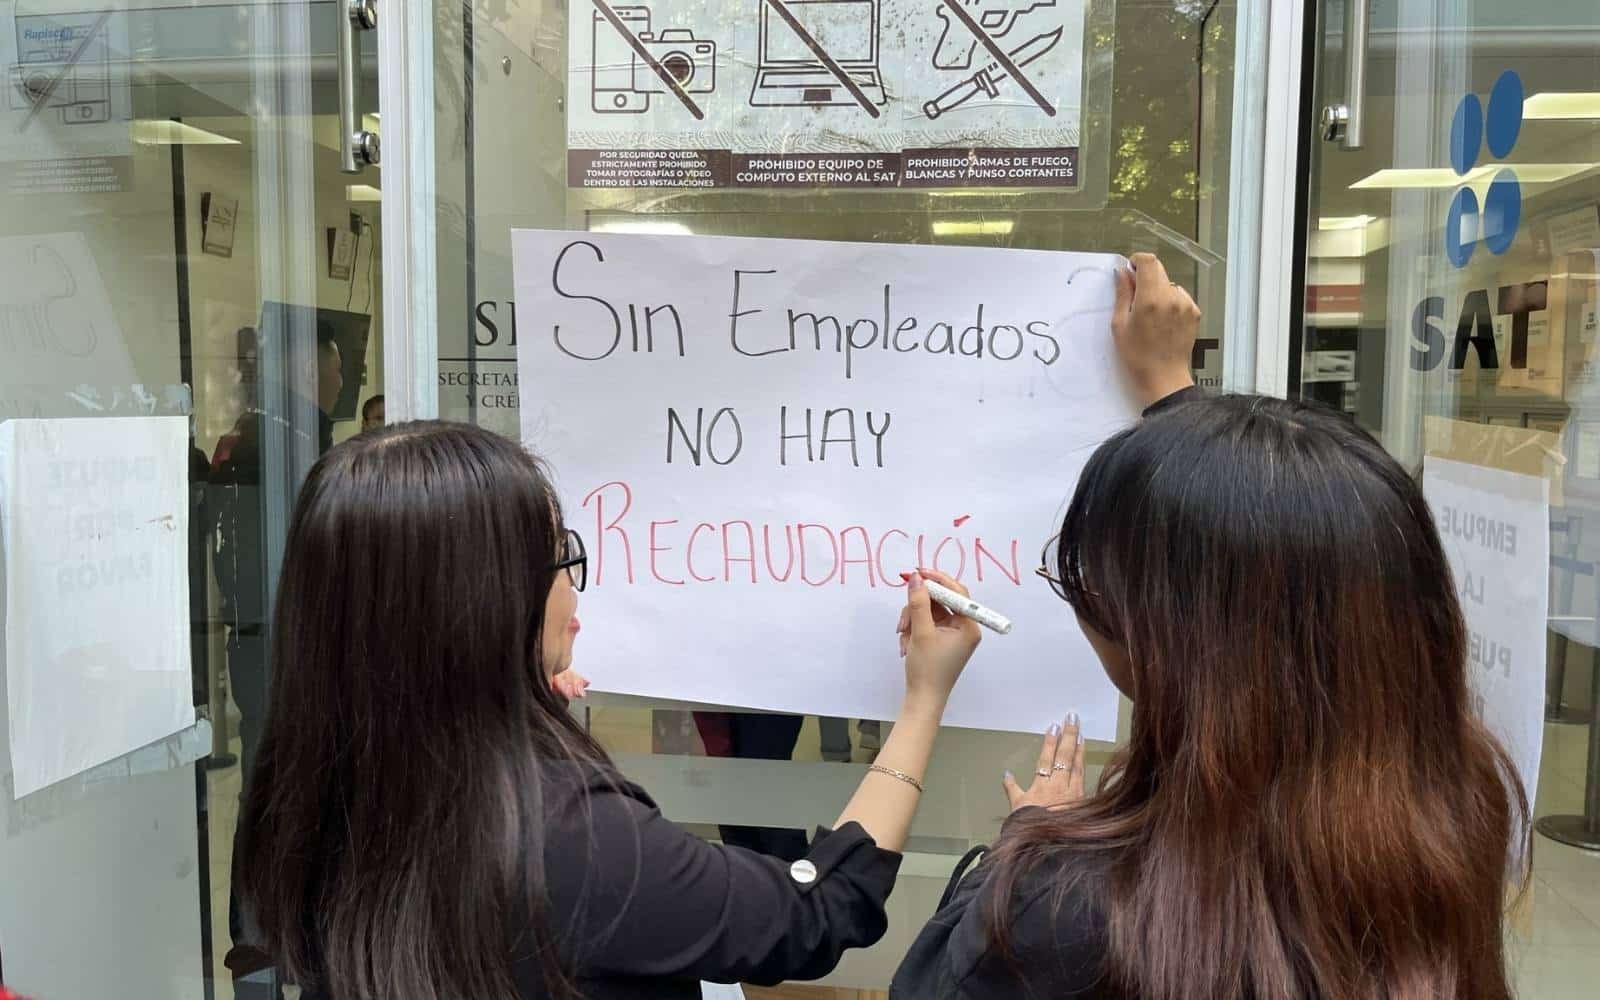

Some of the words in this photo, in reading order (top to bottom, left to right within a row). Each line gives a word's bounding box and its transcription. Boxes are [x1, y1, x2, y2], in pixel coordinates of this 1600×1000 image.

[599, 151, 617, 159] POR
[619, 151, 667, 159] SEGURIDAD
[669, 151, 699, 159] QUEDA
[591, 160, 658, 168] ESTRICTAMENTE
[659, 160, 707, 168] PROHIBIDO
[748, 159, 816, 170] PROHIBIDO
[818, 159, 864, 170] EQUIPO
[867, 159, 884, 169] DE
[907, 158, 969, 168] PROHIBIDO
[970, 157, 1010, 167] ARMAS
[1013, 157, 1029, 166] DE
[1031, 156, 1072, 167] FUEGO,
[586, 169, 616, 177] TOMAR
[617, 168, 675, 177] FOTOGRAFÍAS
[676, 169, 684, 177] O
[736, 172, 796, 182] COMPUTO
[798, 172, 853, 182] EXTERNO
[855, 172, 871, 182] AL
[873, 172, 896, 182] SAT
[905, 169, 956, 179] BLANCAS
[958, 169, 966, 178] Y
[968, 169, 1006, 178] PUNSO
[1008, 168, 1074, 178] CORTANTES
[583, 179, 618, 187] DENTRO
[619, 179, 631, 187] DE
[632, 179, 648, 187] LAS
[649, 179, 715, 187] INSTALACIONES
[552, 240, 685, 361] Sin
[729, 269, 1062, 379] Empleados
[1410, 280, 1548, 371] SAT
[481, 391, 520, 408] CRÉ
[666, 407, 743, 467] NO
[779, 405, 891, 468] HAY
[582, 481, 1022, 589] RECAUDACIÓN
